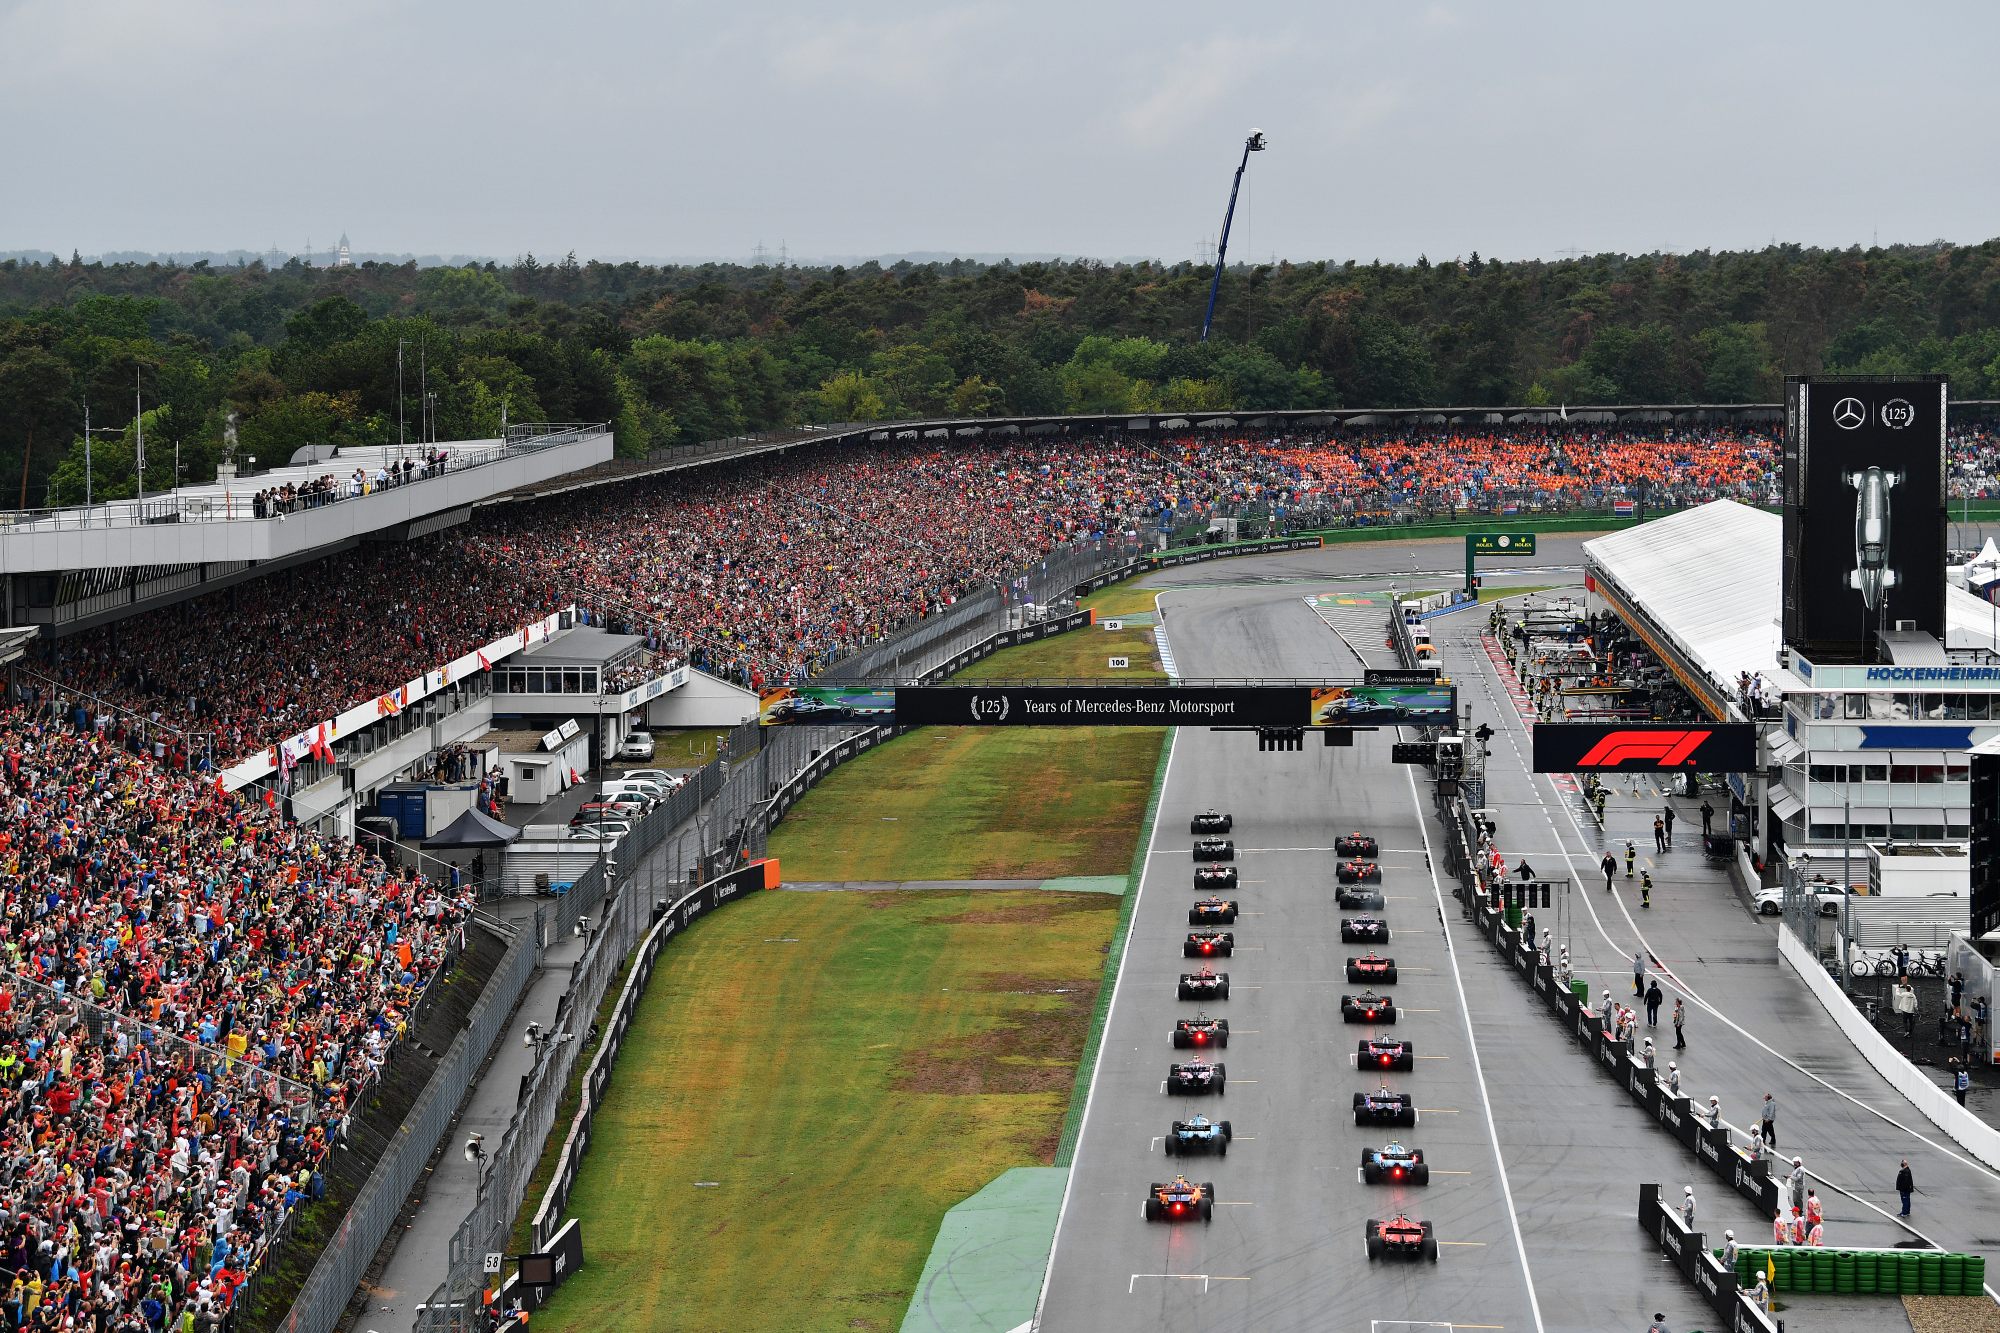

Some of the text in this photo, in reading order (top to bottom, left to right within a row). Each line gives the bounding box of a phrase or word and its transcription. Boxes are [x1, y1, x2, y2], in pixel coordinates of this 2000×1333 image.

[1889, 408, 1906, 420] 125
[980, 700, 1000, 713] 125
[1024, 699, 1235, 716] Years of Mercedes-Benz Motorsport
[486, 1256, 499, 1268] 58
